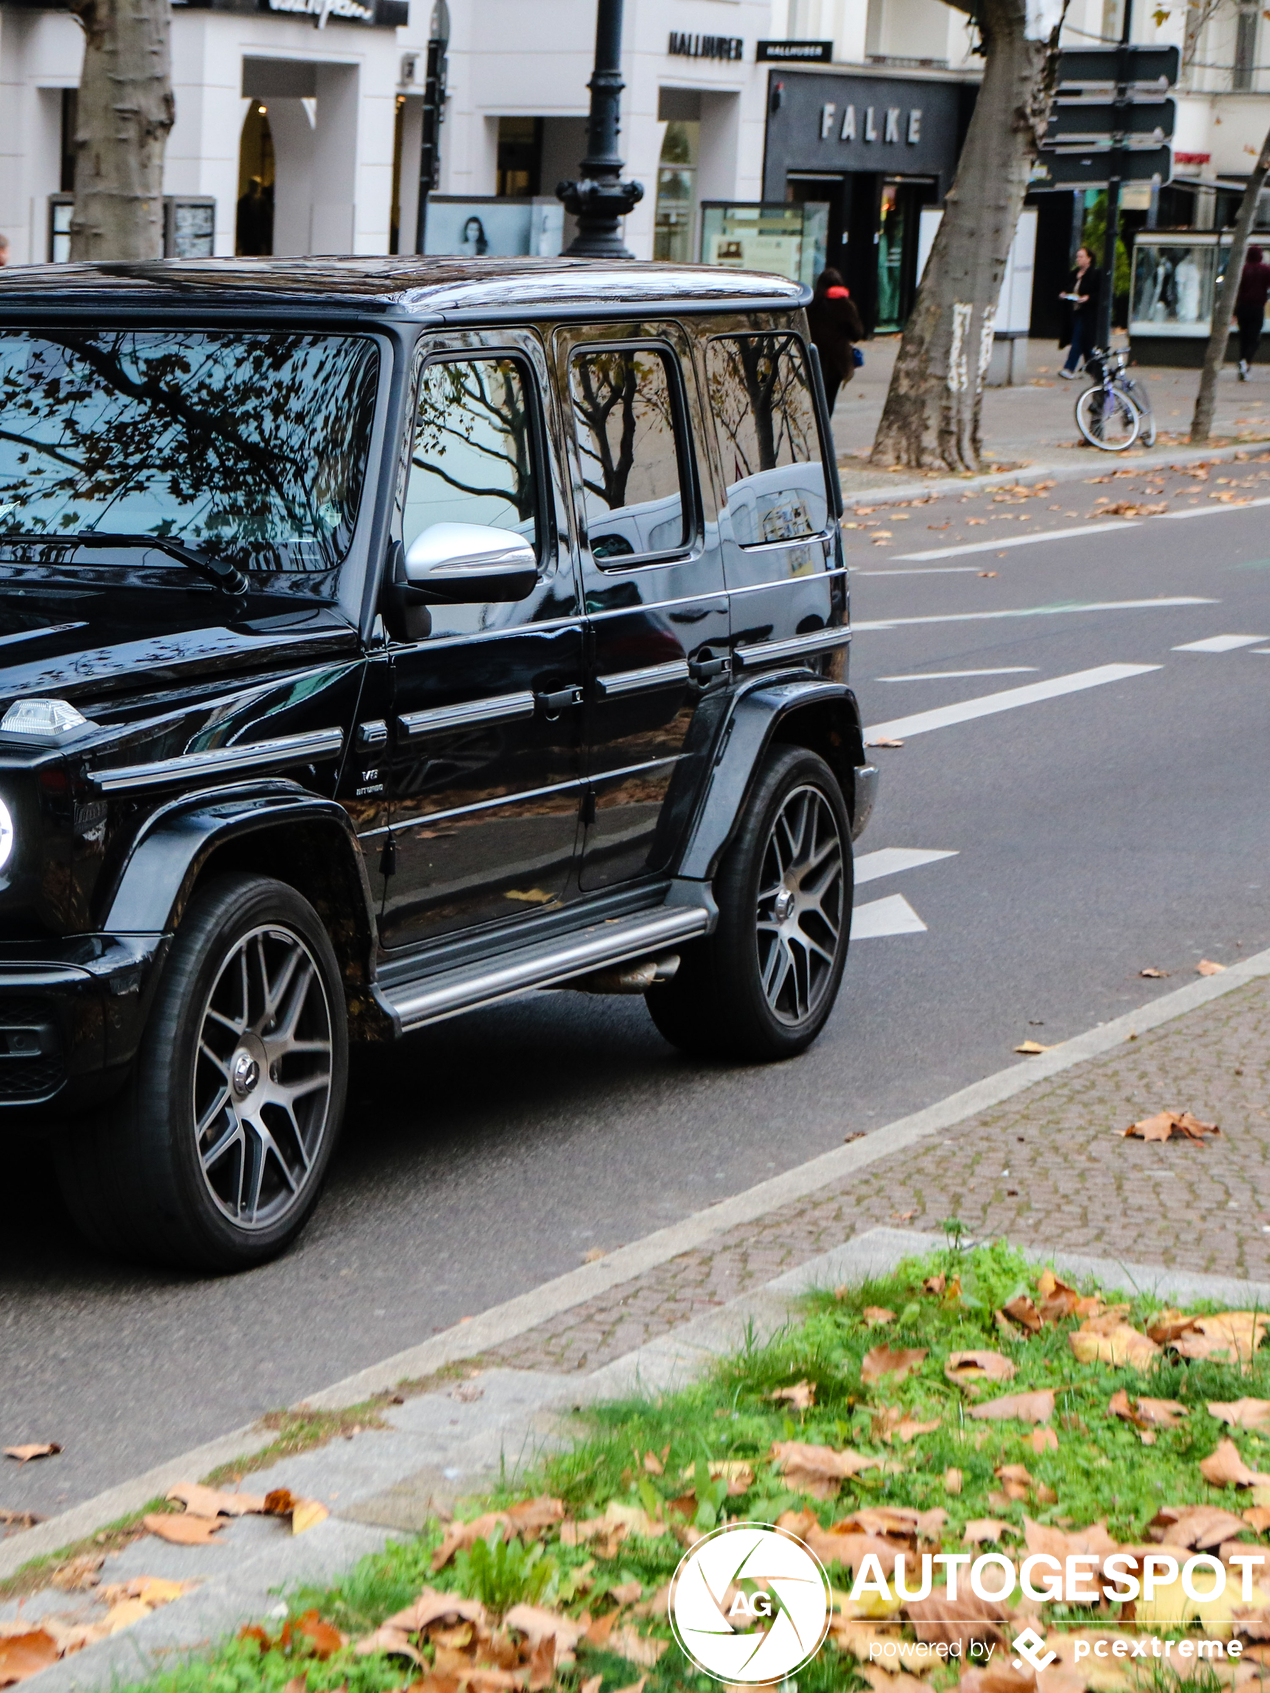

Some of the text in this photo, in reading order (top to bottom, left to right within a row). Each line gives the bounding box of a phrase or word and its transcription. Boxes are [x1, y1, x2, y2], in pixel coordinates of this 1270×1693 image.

[669, 32, 744, 61] HALLHUBER
[766, 45, 823, 57] HALLHUBER
[821, 102, 923, 144] FALKE
